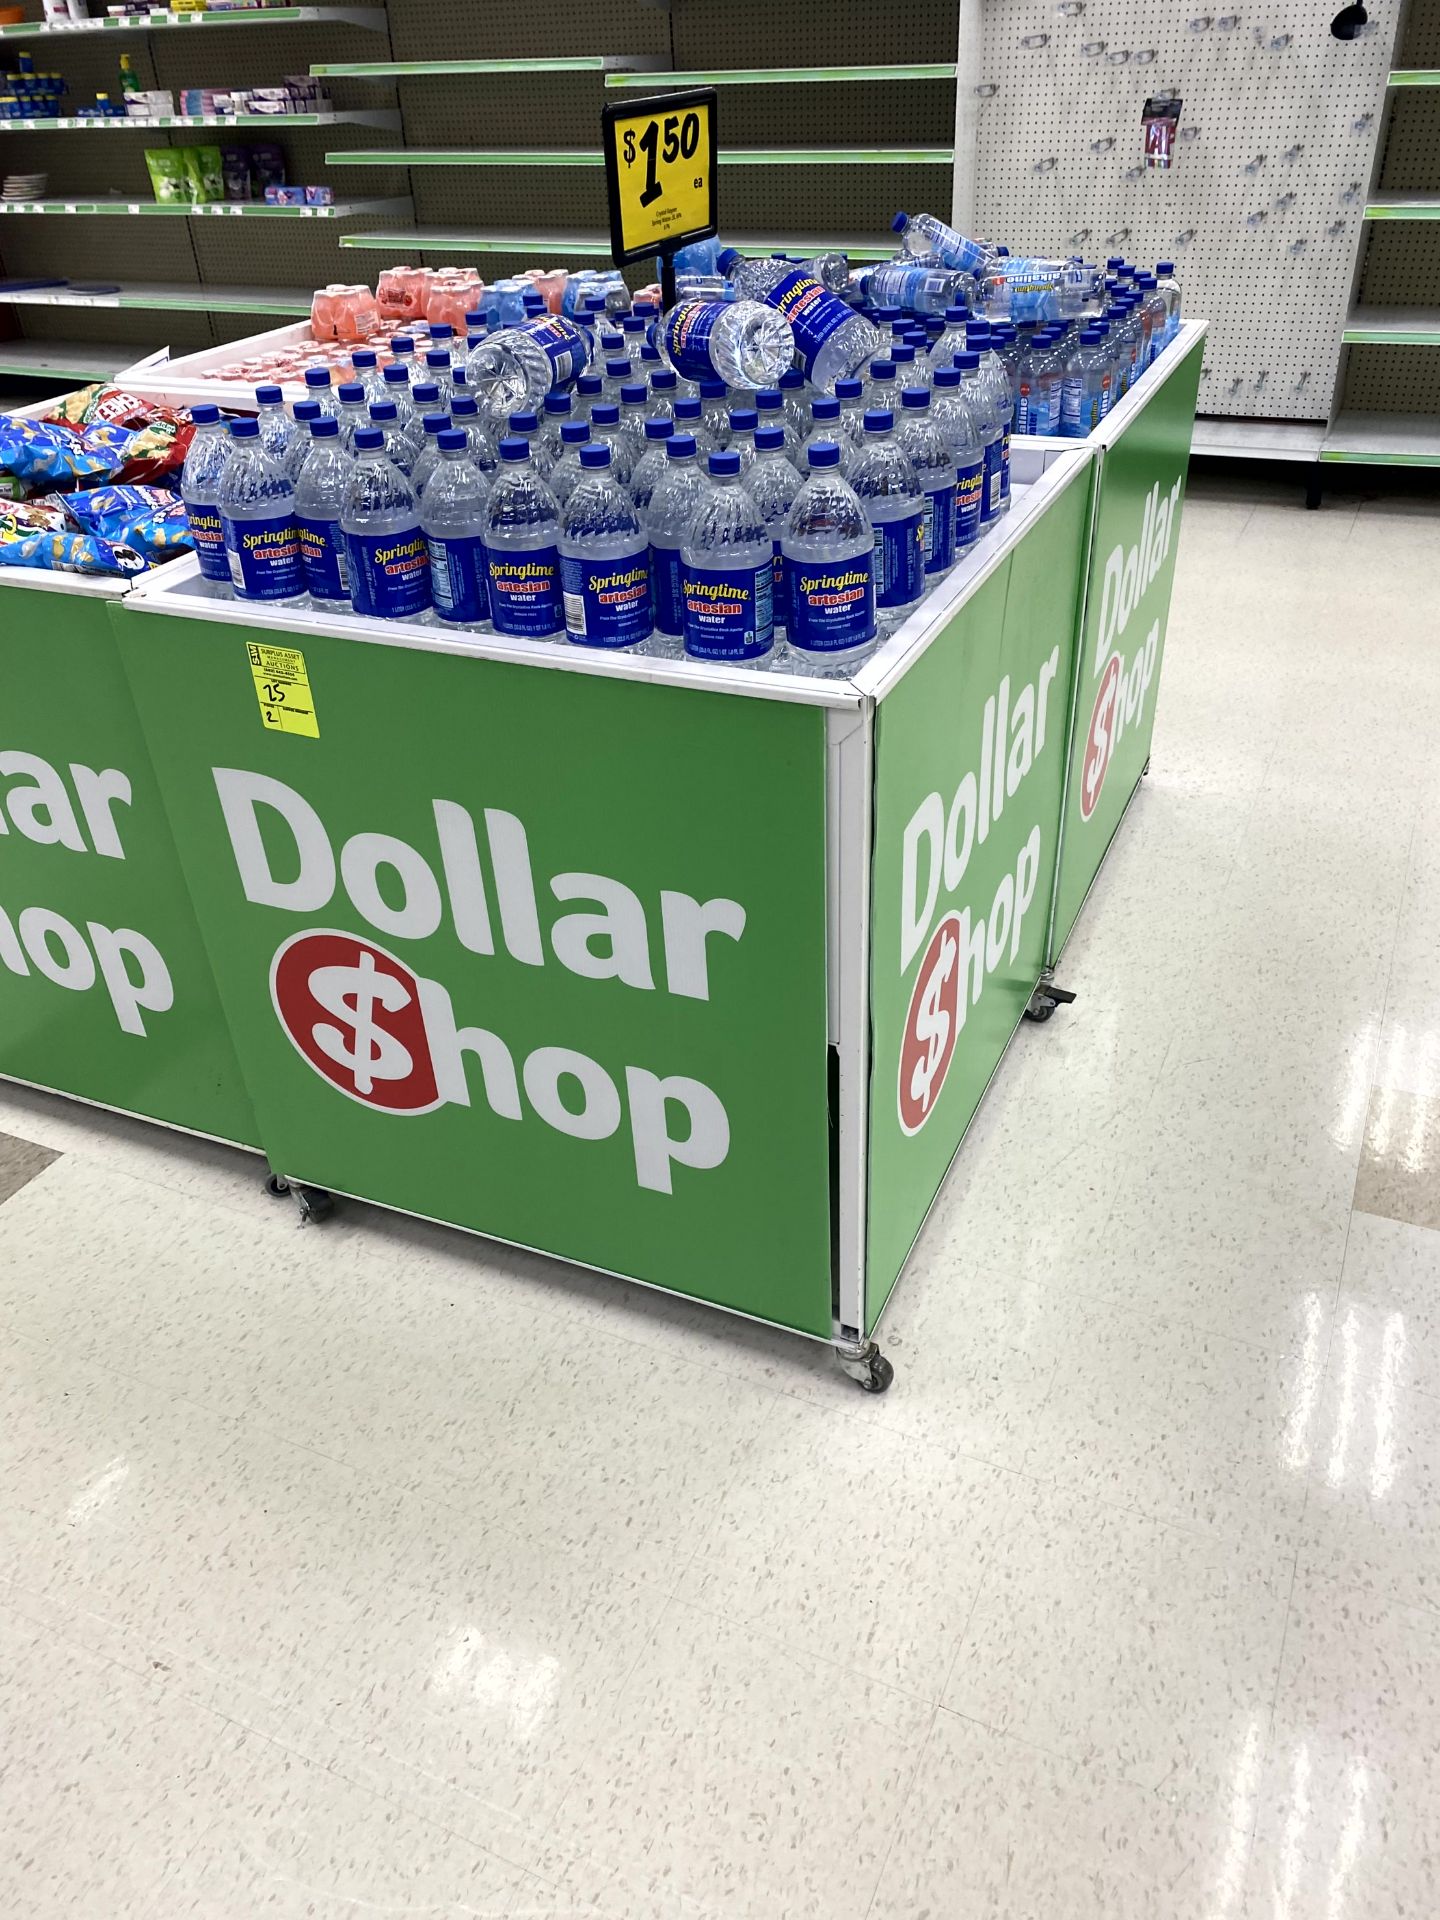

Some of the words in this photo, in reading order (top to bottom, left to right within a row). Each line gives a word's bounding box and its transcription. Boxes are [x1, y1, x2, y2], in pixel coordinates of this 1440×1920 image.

[693, 177, 703, 188] ea
[269, 556, 294, 567] water
[401, 568, 422, 581] water
[489, 561, 555, 580] Springtime
[1093, 475, 1181, 677] Dollar
[496, 579, 551, 594] artesian
[799, 570, 869, 595] Springtime
[598, 583, 648, 605] artesian
[683, 579, 749, 601] Springtime
[808, 586, 865, 606] artesian
[510, 593, 536, 602] water
[615, 600, 639, 613] water
[687, 599, 743, 615] artesian
[824, 603, 852, 615] water
[698, 614, 726, 624] water
[284, 652, 300, 660] ASSET
[265, 660, 299, 671] AUCTIONS
[266, 710, 279, 723] 2
[900, 645, 1059, 977] Dollar
[211, 766, 747, 1001] Dollar
